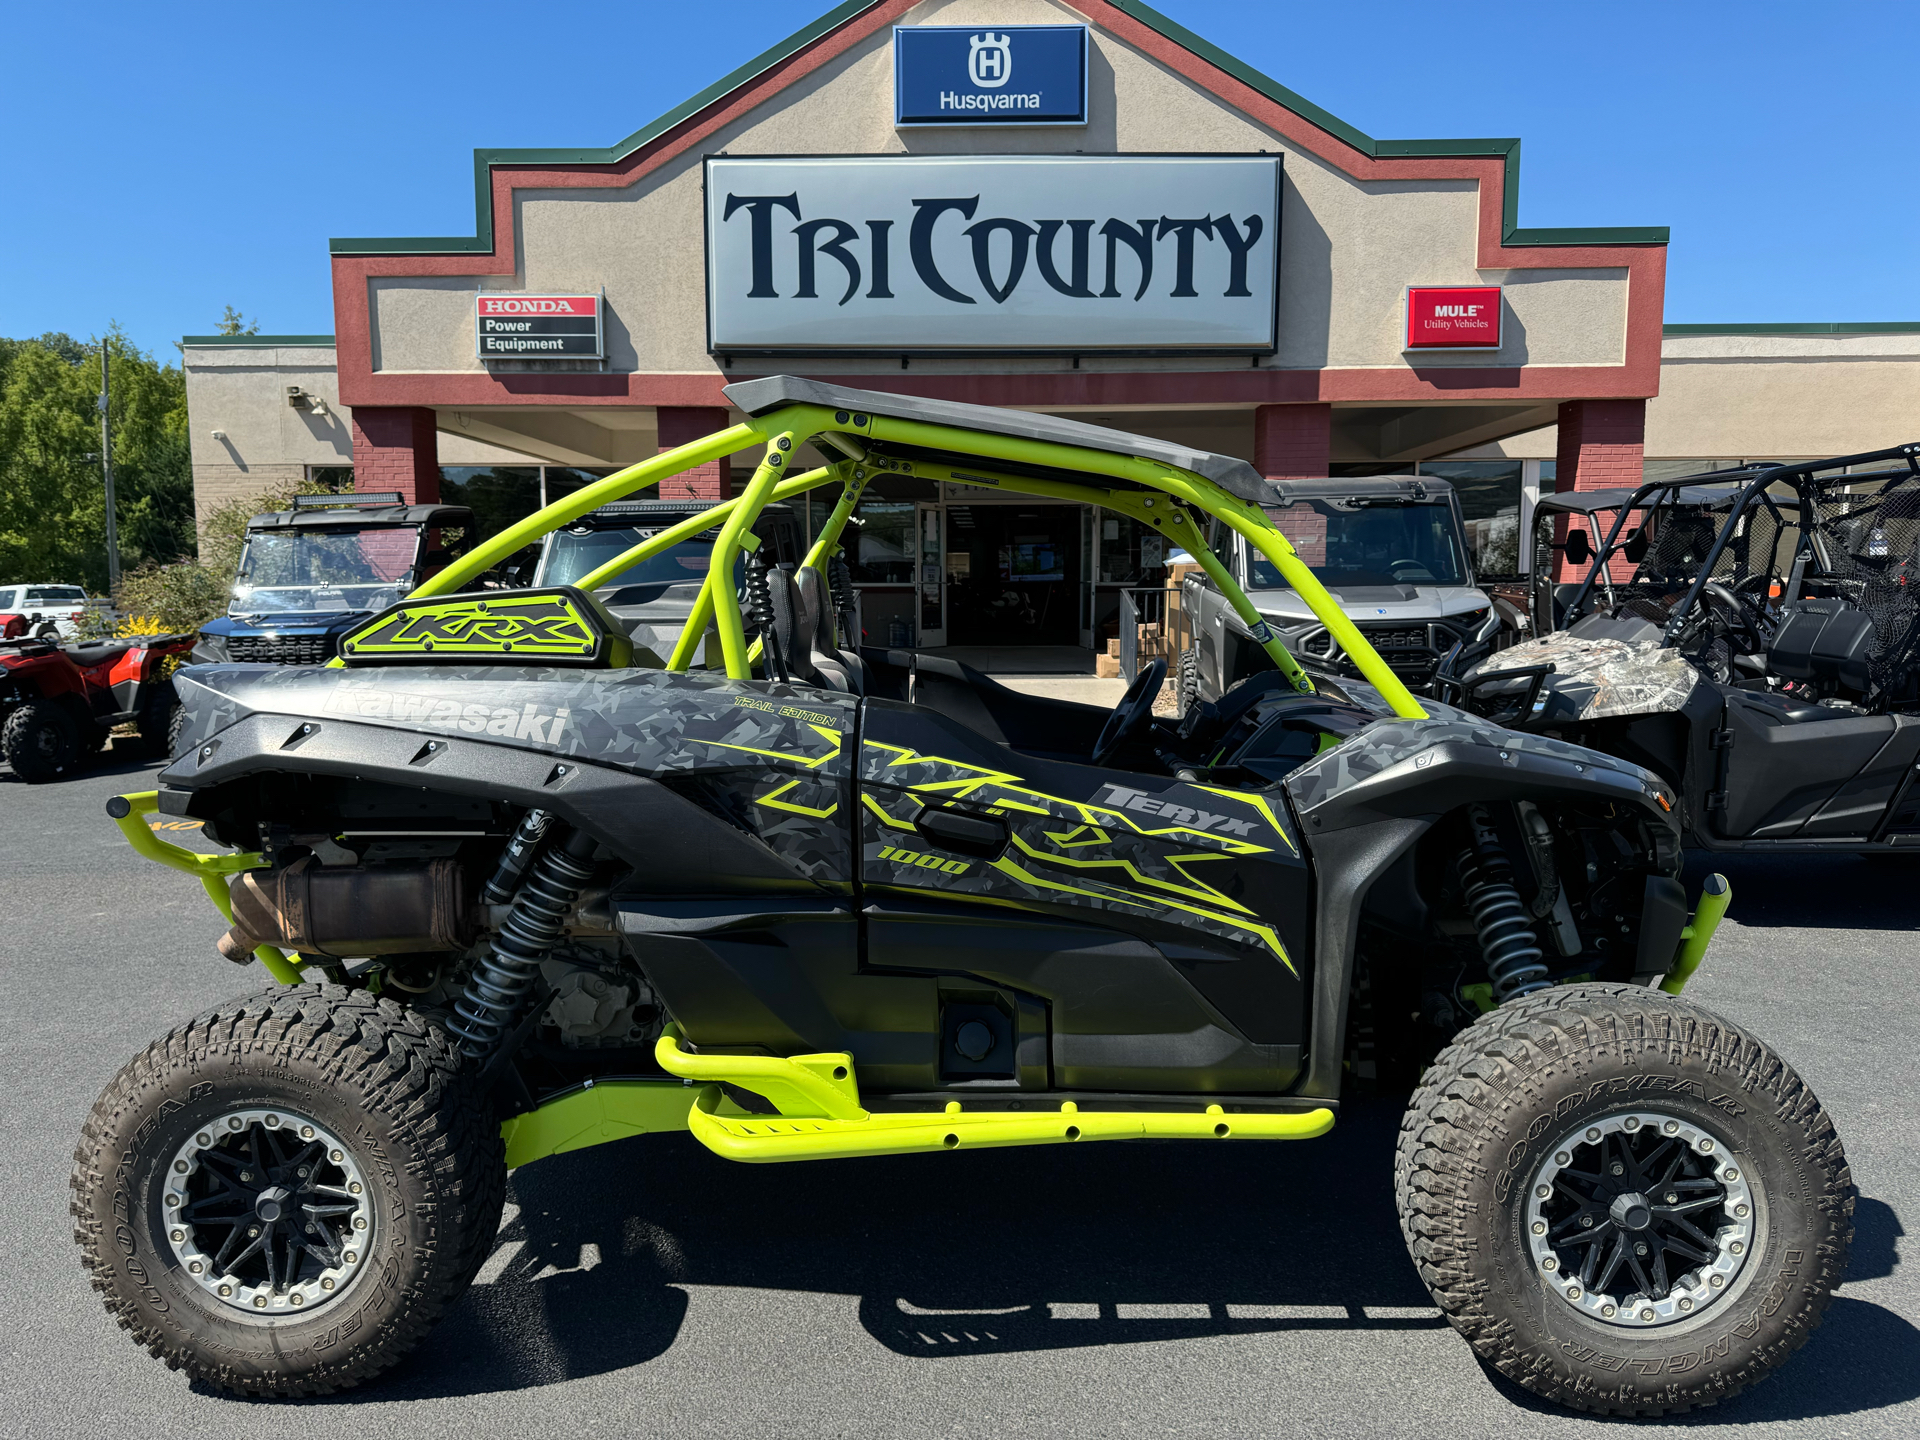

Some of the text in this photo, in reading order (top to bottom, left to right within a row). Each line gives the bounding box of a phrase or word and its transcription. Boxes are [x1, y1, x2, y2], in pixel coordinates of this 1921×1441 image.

[940, 91, 1041, 112] Husqvarna
[485, 300, 574, 312] HONDA
[485, 319, 532, 331] Power
[1424, 319, 1489, 330] Utility Vehicles
[486, 337, 564, 351] Equipment
[391, 610, 580, 643] KRX
[323, 680, 570, 747] Kawasaki
[734, 695, 838, 727] TRAIL EDITION
[877, 845, 971, 876] 1000
[1493, 1074, 1747, 1203] GOODYEAR
[111, 1080, 214, 1313] GOODYEAR
[312, 1120, 406, 1351] WRANGLER
[1561, 1249, 1804, 1375] WRANGLER
